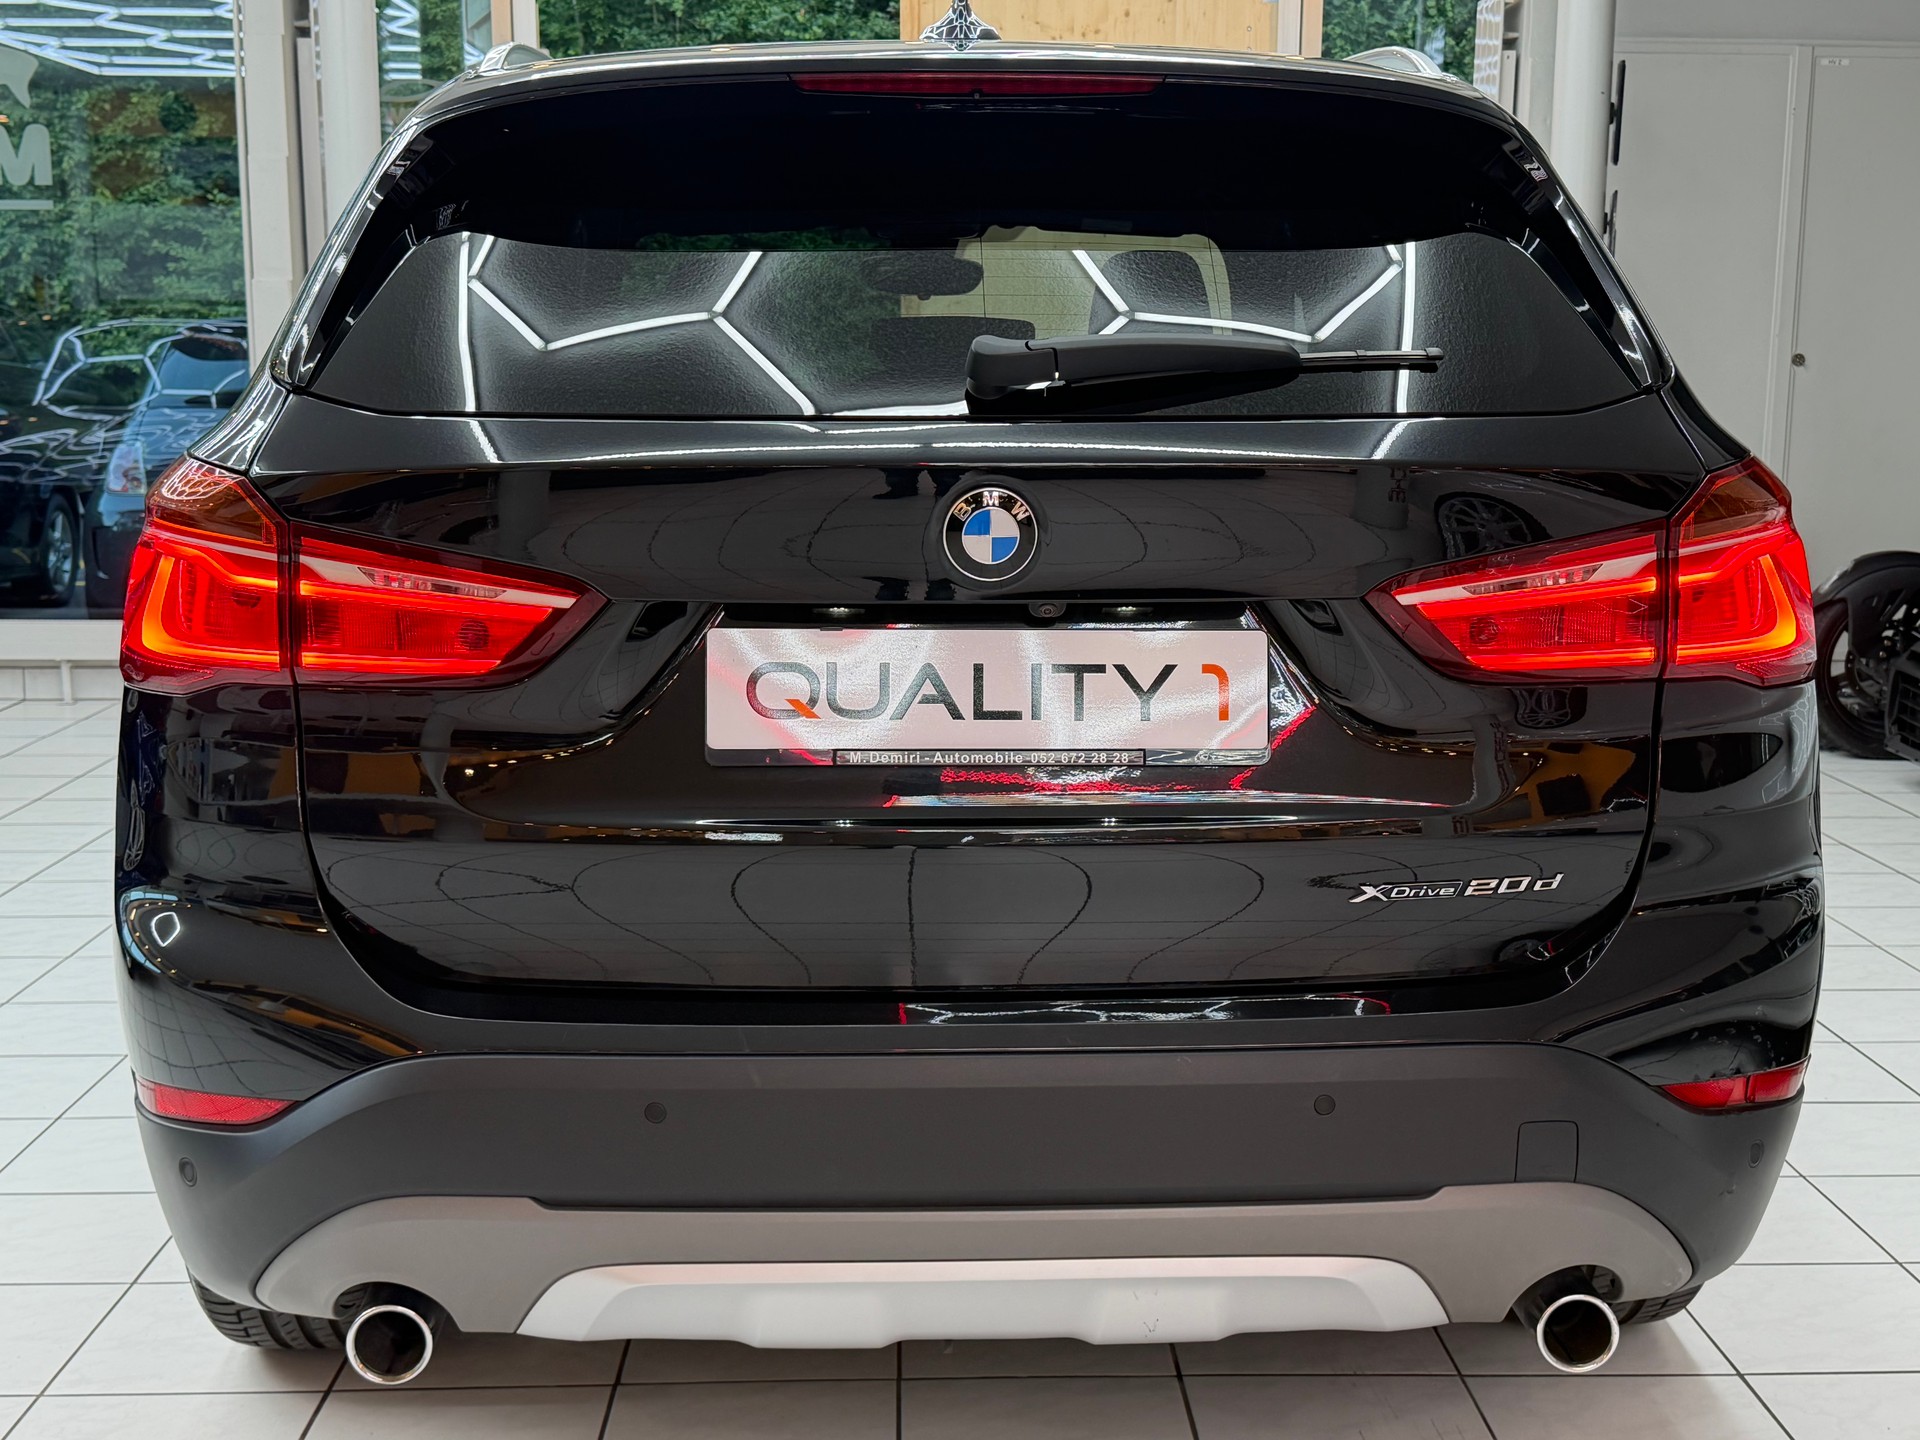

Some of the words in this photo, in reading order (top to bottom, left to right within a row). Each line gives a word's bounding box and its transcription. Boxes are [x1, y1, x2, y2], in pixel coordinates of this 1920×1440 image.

[953, 491, 1030, 521] BMW
[745, 662, 1178, 721] QUALITY
[1201, 663, 1230, 721] 1
[1061, 752, 1086, 764] 672
[1091, 752, 1107, 764] 28
[1113, 752, 1129, 764] 28
